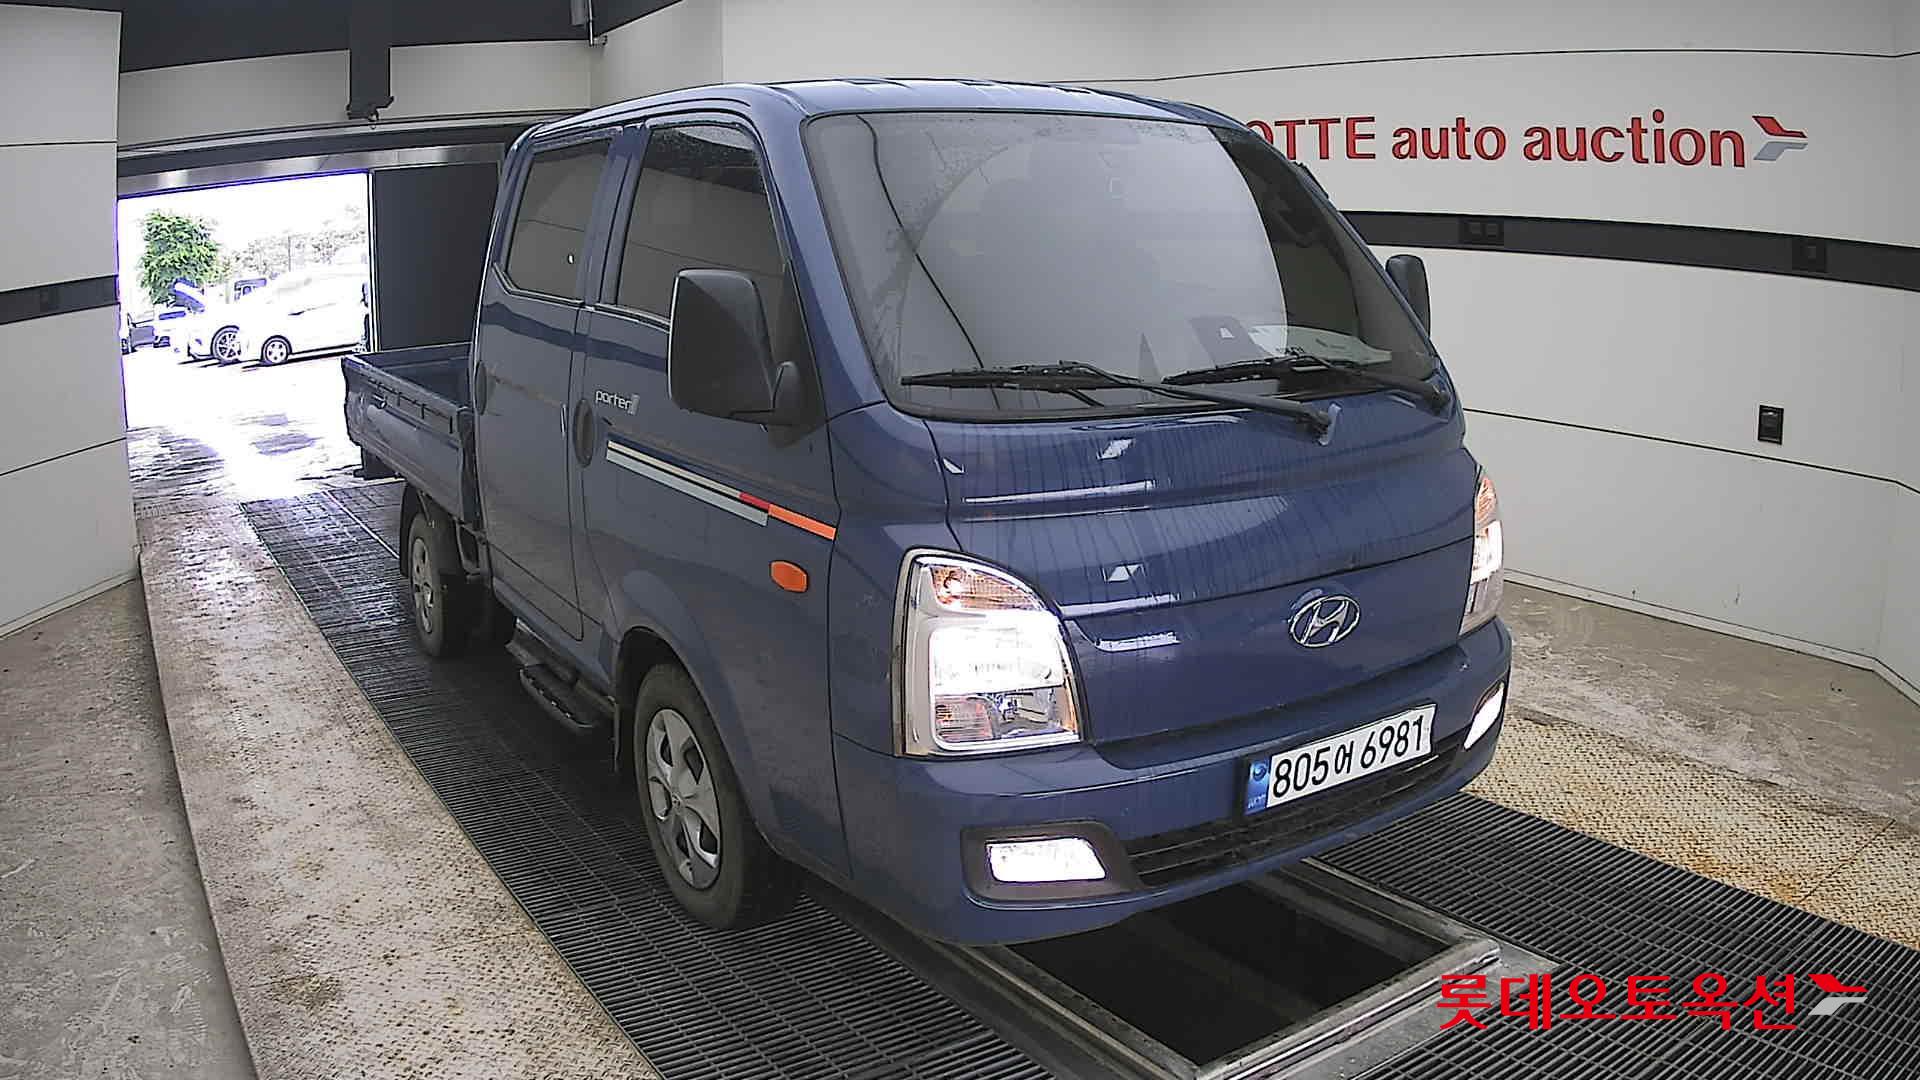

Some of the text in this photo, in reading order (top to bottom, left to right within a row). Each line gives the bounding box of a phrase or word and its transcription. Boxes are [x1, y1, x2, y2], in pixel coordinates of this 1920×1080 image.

[1392, 117, 1507, 160] auto
[1523, 109, 1746, 168] auction
[595, 390, 633, 410] porter
[1360, 715, 1424, 769] 6981
